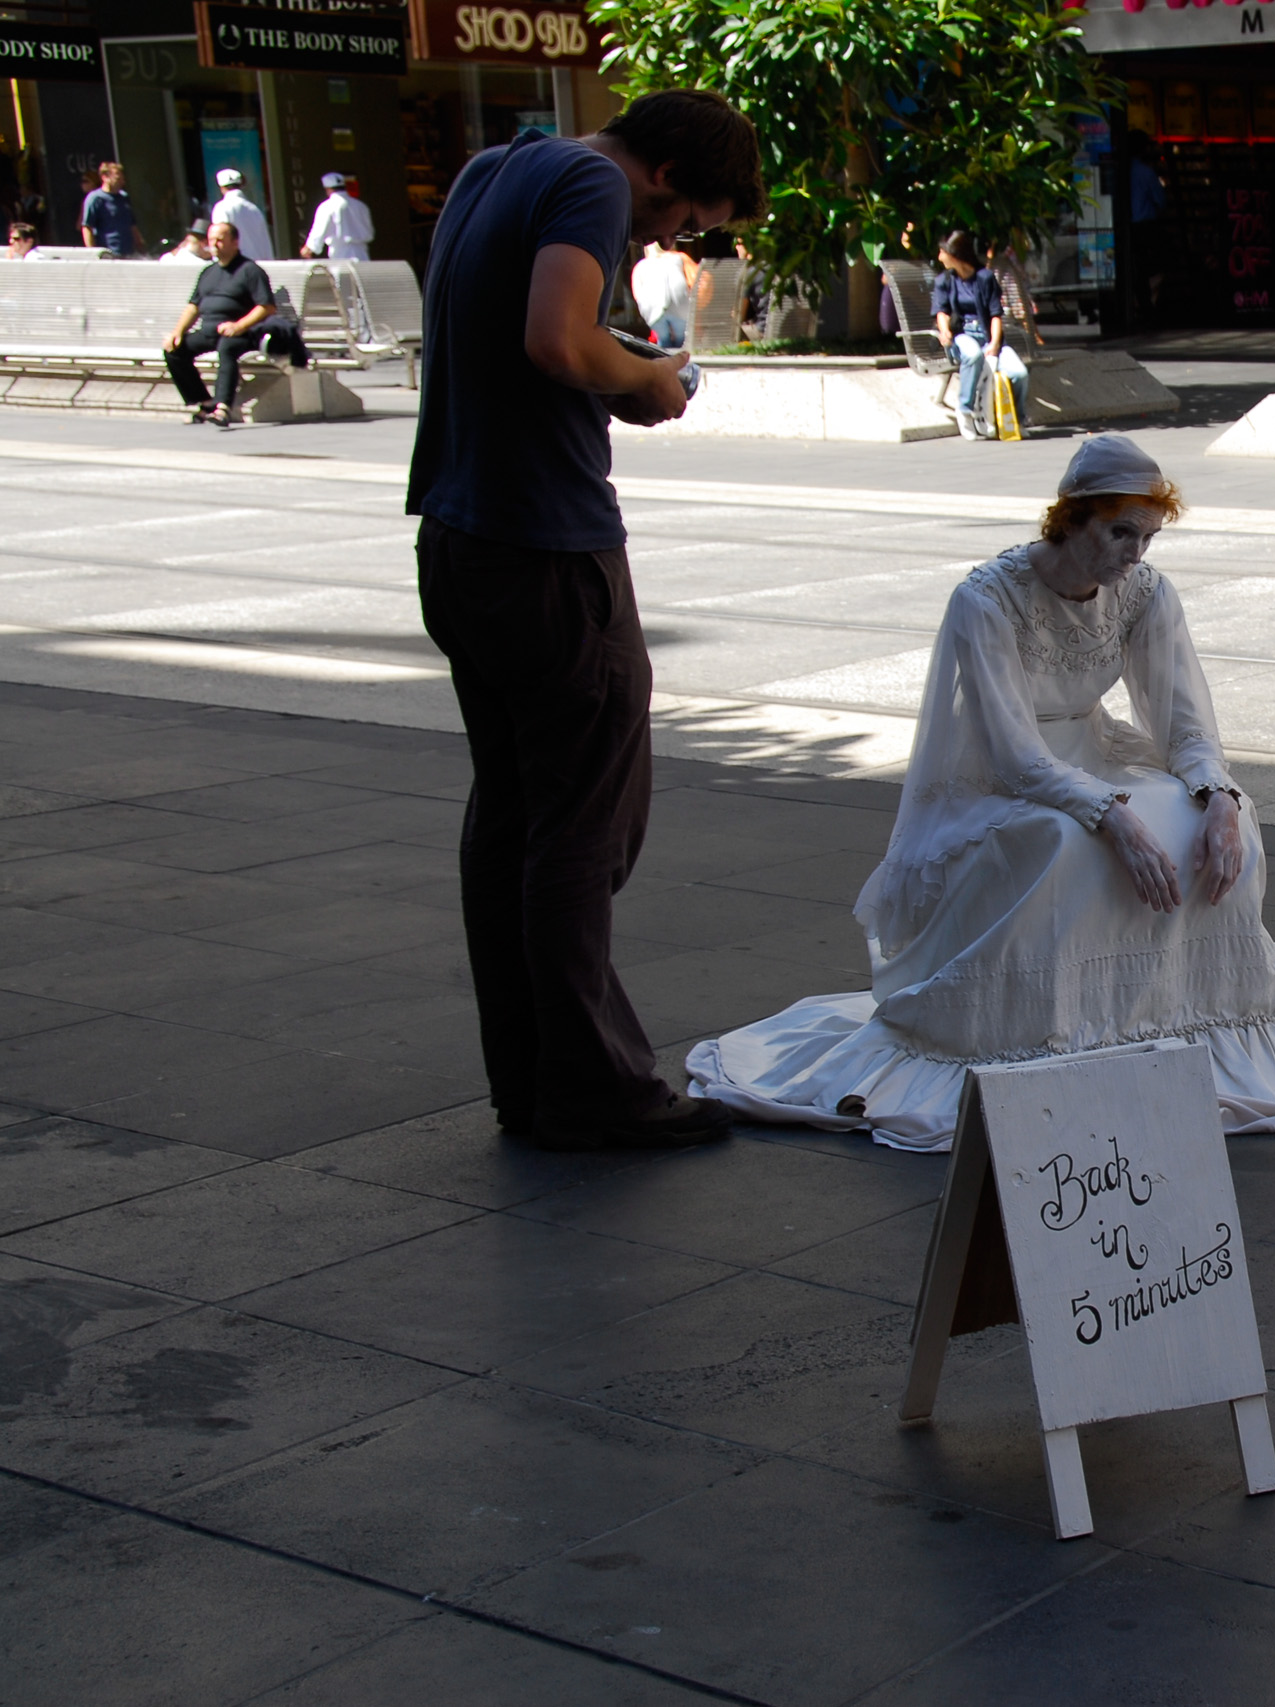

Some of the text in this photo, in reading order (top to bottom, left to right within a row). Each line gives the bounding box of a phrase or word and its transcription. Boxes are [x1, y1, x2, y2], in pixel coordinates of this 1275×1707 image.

[40, 41, 93, 62] SHOP
[244, 27, 400, 56] THE BODY SHOP
[455, 5, 588, 58] SHOO BIZ
[1038, 1137, 1152, 1231] Back
[1090, 1220, 1149, 1270] in
[1071, 1223, 1233, 1345] 5 minutes
